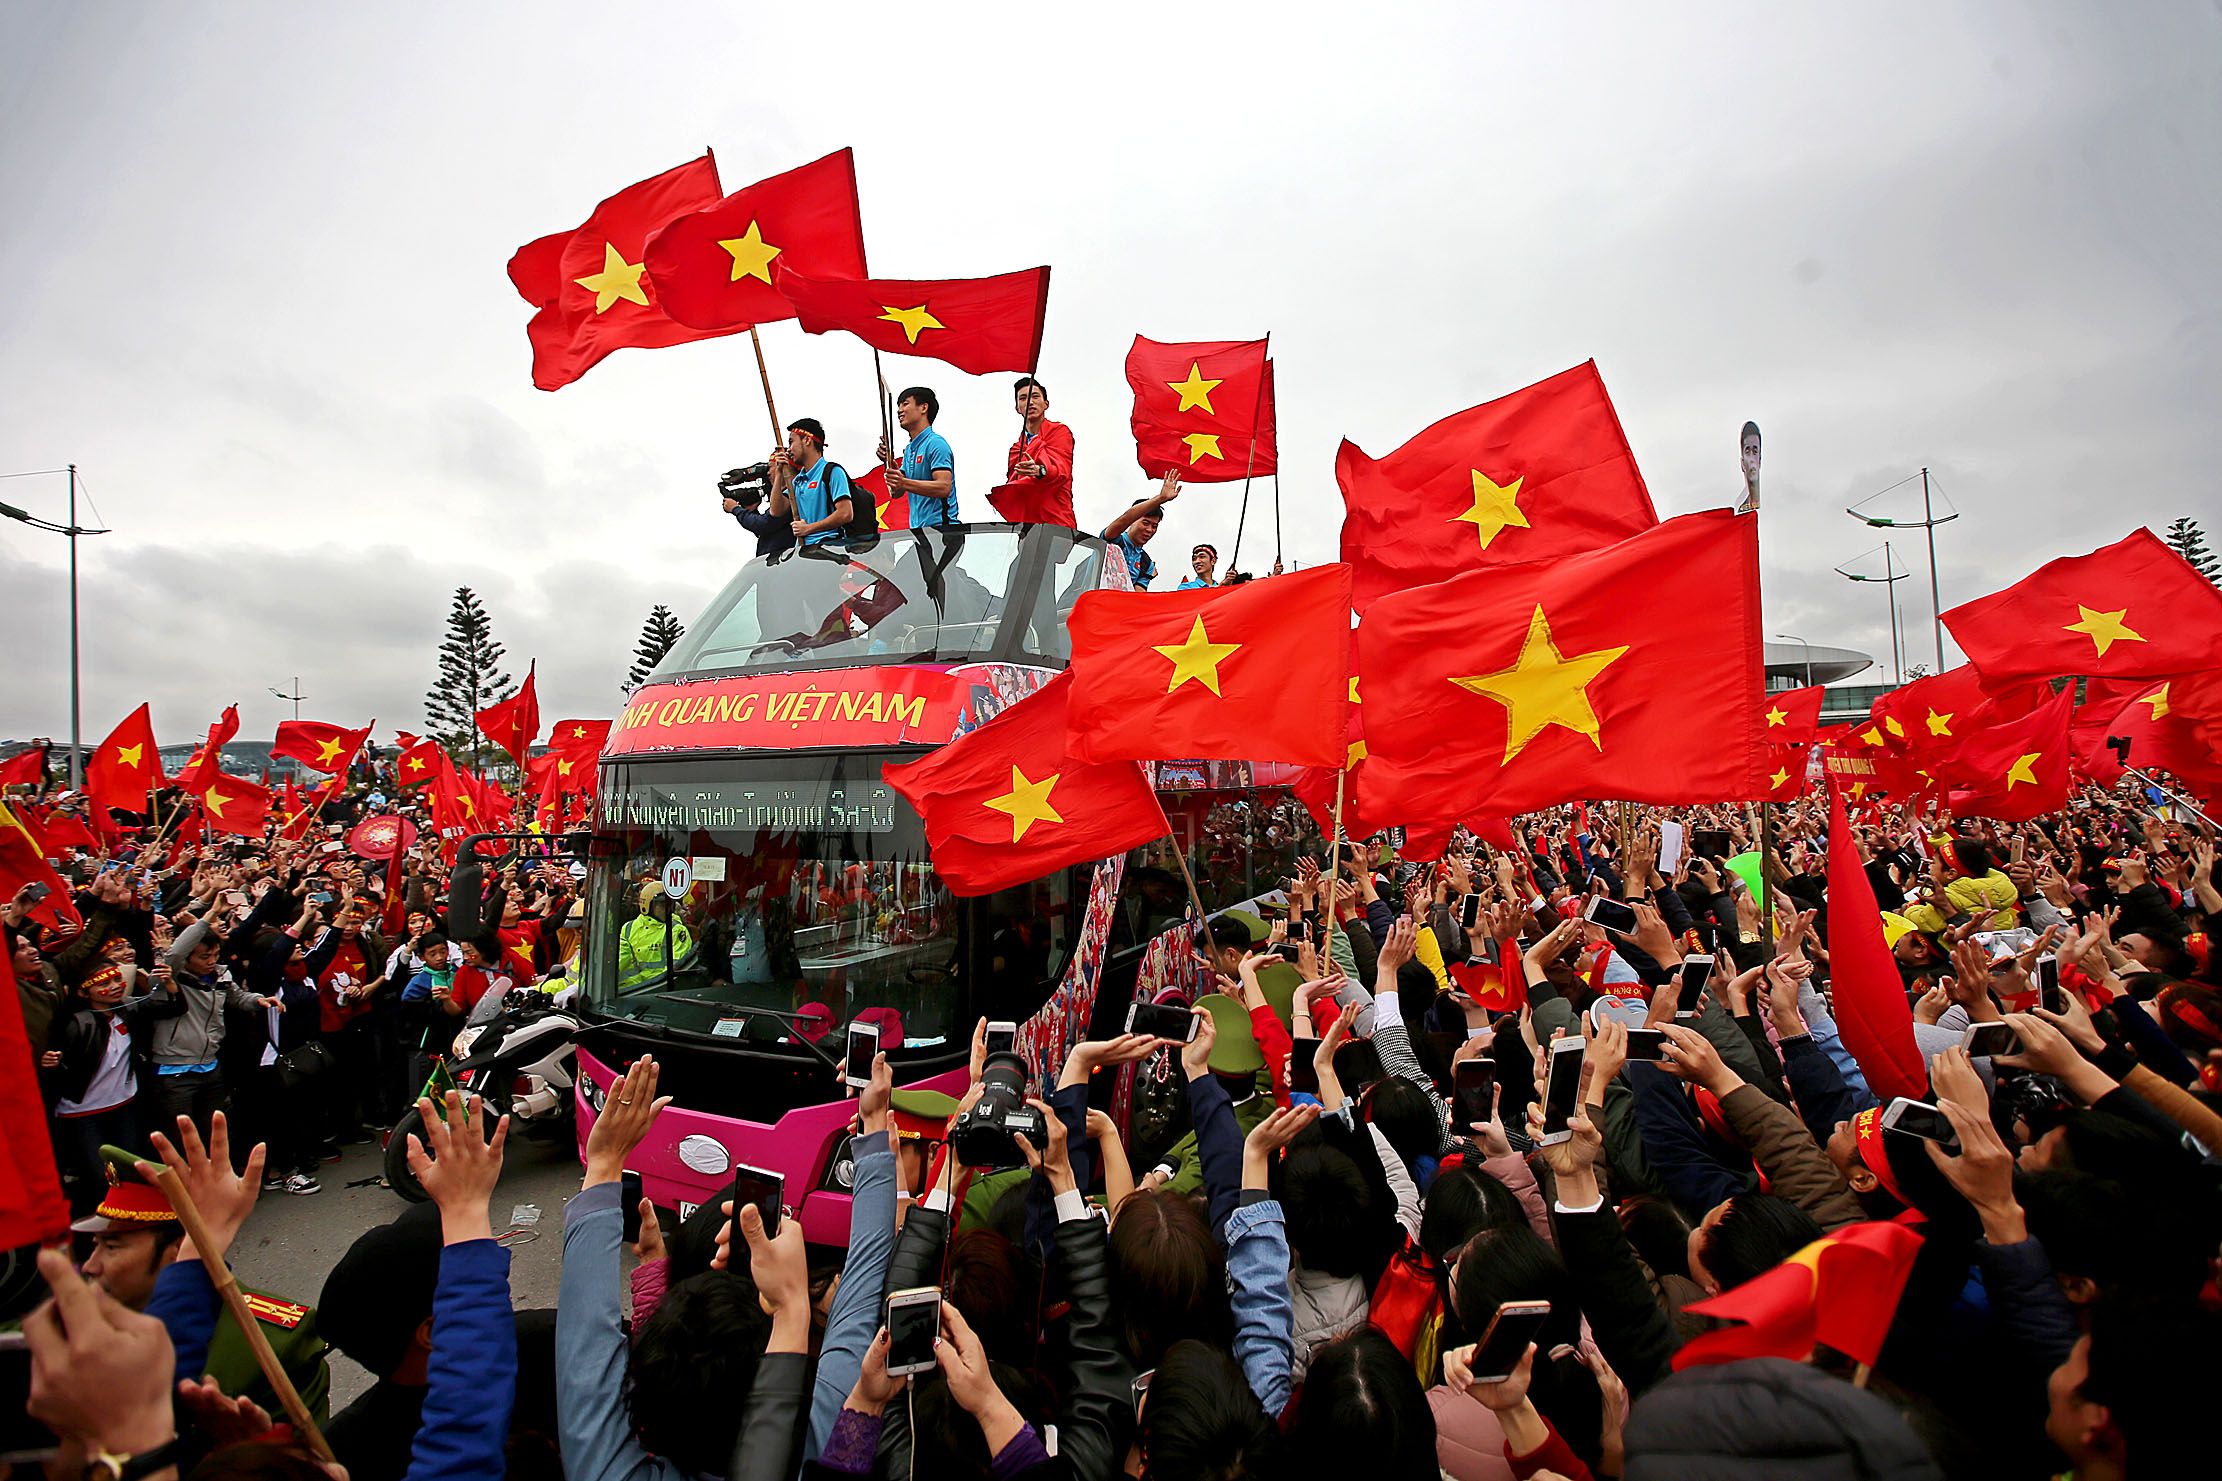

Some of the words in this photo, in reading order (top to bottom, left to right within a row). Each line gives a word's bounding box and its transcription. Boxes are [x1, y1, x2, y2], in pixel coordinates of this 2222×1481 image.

[613, 700, 660, 734] INH
[658, 693, 760, 728] QUANG
[765, 684, 837, 730] VIỆT
[831, 691, 927, 728] NAM
[627, 792, 689, 826] Nguyên
[669, 868, 685, 888] N1
